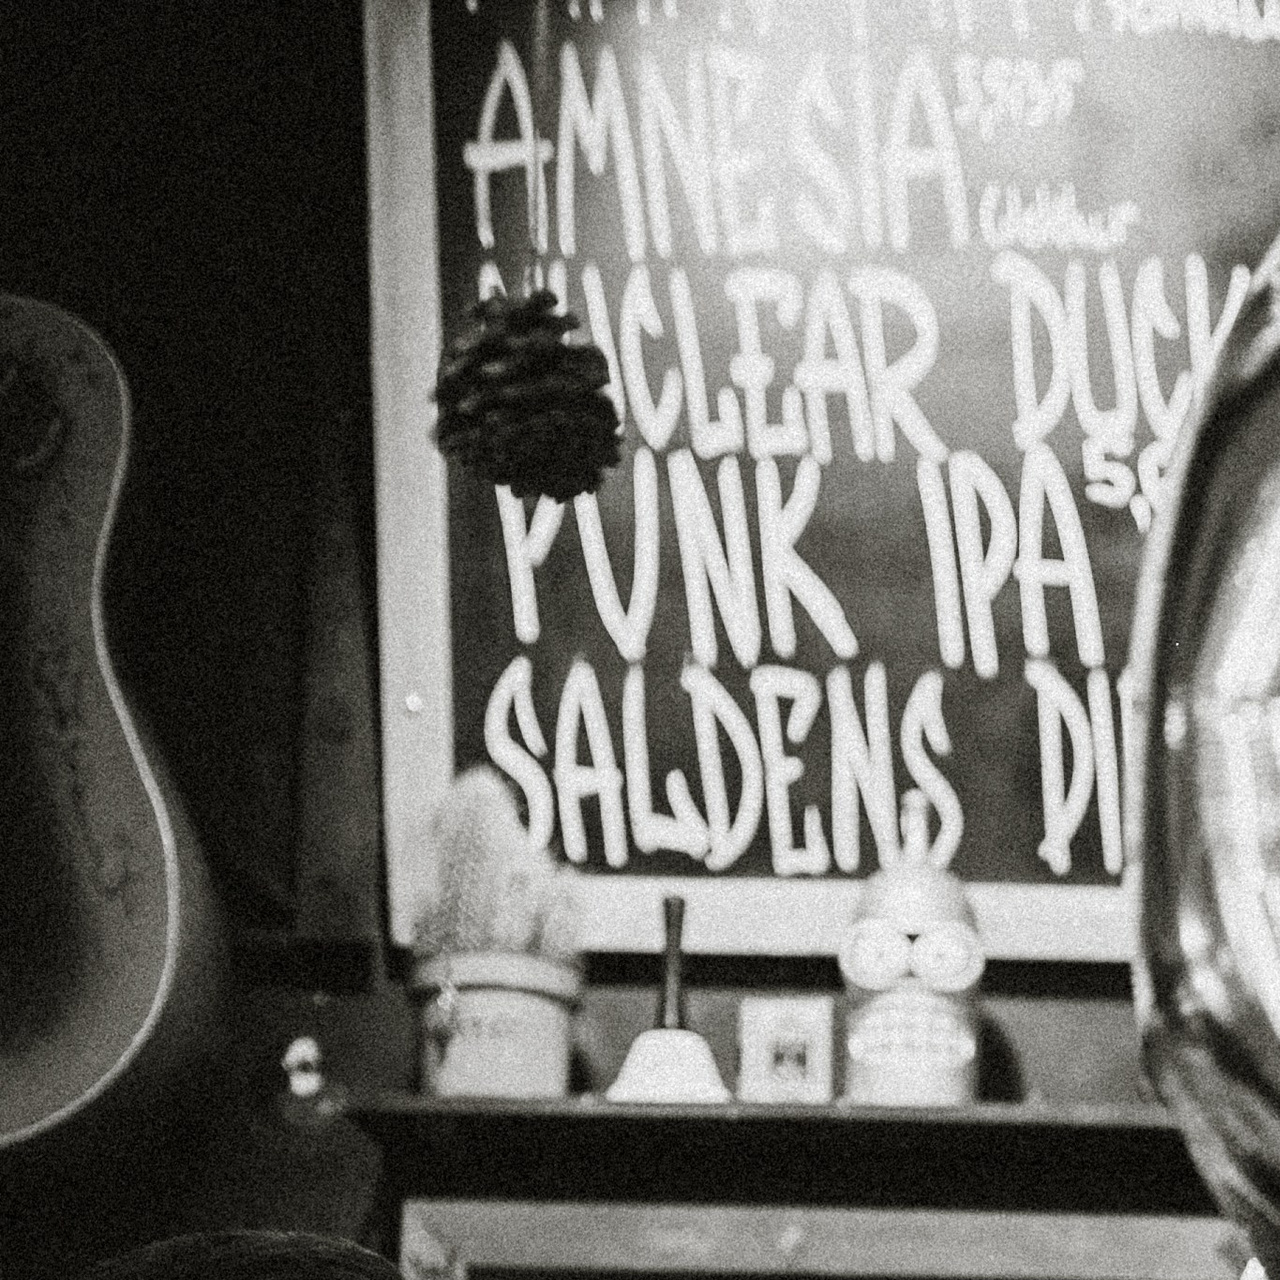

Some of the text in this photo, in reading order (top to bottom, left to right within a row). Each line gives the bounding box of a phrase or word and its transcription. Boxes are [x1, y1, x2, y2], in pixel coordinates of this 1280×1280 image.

[463, 40, 970, 255] AMNESIA
[478, 250, 1252, 462] UCLEAR DUCK
[914, 441, 1104, 678] IPA
[484, 655, 964, 876] SALDENS
